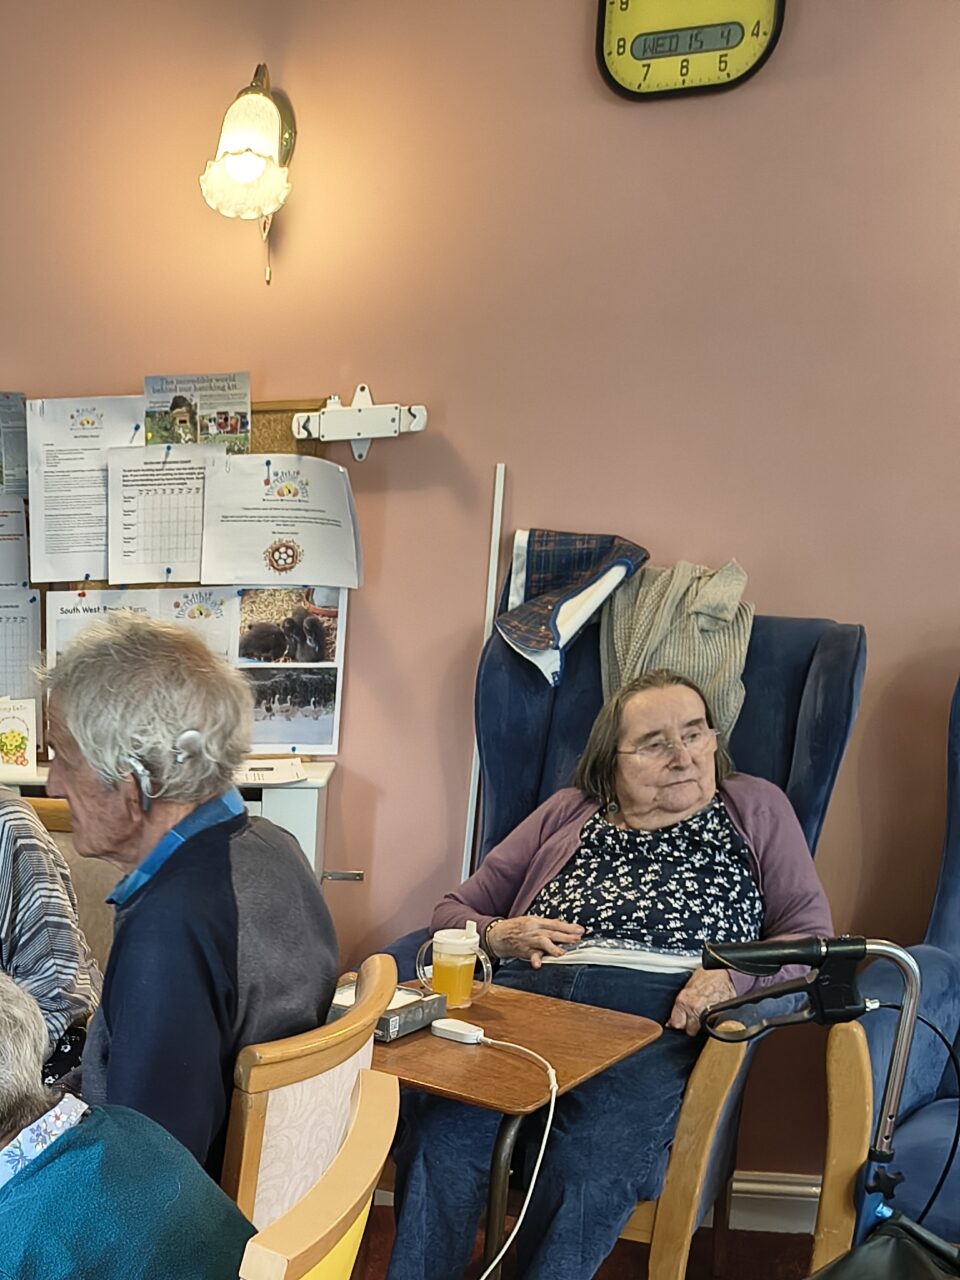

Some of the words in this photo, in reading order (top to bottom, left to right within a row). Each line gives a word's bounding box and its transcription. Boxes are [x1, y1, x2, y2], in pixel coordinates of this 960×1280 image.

[750, 20, 761, 38] 4
[616, 37, 627, 56] 8
[642, 33, 679, 57] WED
[688, 30, 704, 50] 15
[720, 28, 732, 47] 4
[718, 54, 729, 73] 5
[641, 64, 652, 82] 7
[59, 606, 81, 615] South
[82, 605, 101, 614] West
